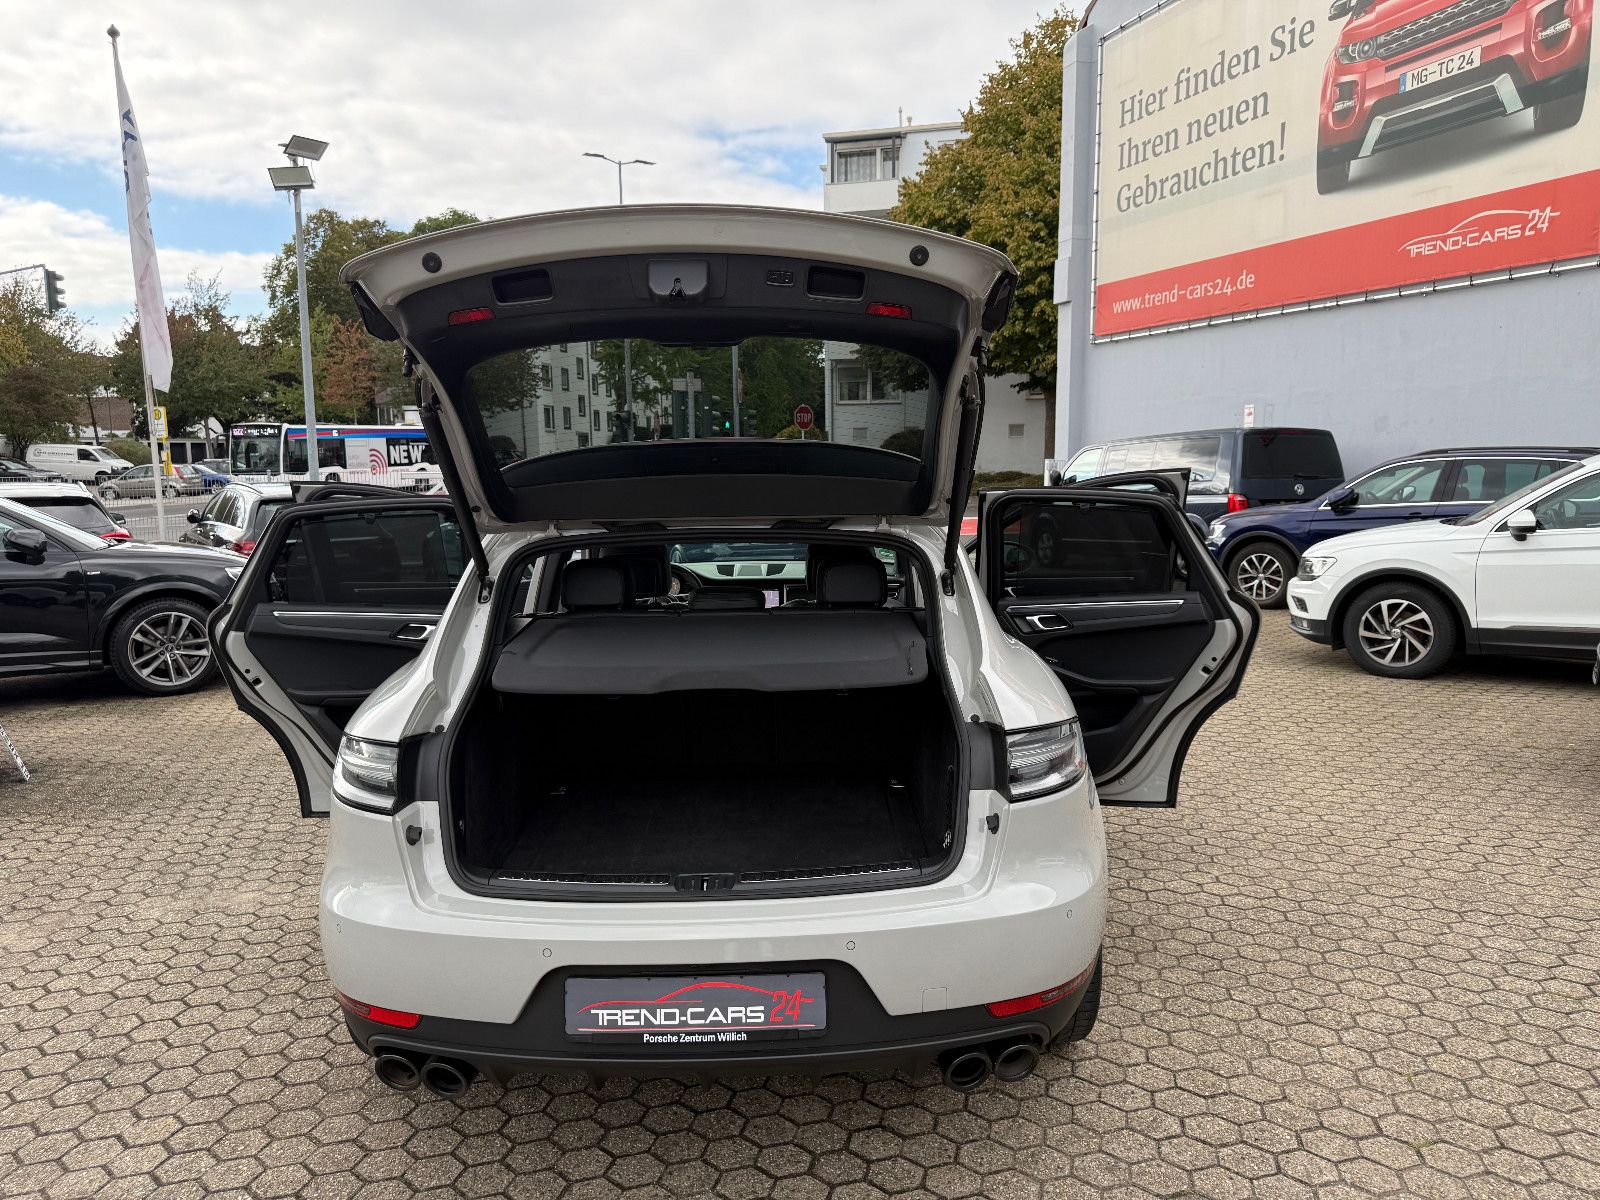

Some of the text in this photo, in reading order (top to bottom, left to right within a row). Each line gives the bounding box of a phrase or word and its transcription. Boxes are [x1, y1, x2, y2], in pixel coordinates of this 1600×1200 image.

[1119, 17, 1315, 128] Hier finden Sie
[1457, 51, 1474, 71] 24
[1118, 91, 1270, 171] Ihren neuen
[1116, 122, 1286, 212] Gebrauchten!
[1406, 206, 1552, 257] TREND-CARS 24
[1113, 269, 1255, 314] www.trend-cars24.de
[796, 413, 812, 422] STOP
[591, 989, 803, 1026] TREND-CARS 24
[643, 1031, 747, 1043] Porsche Zentrum Willich
